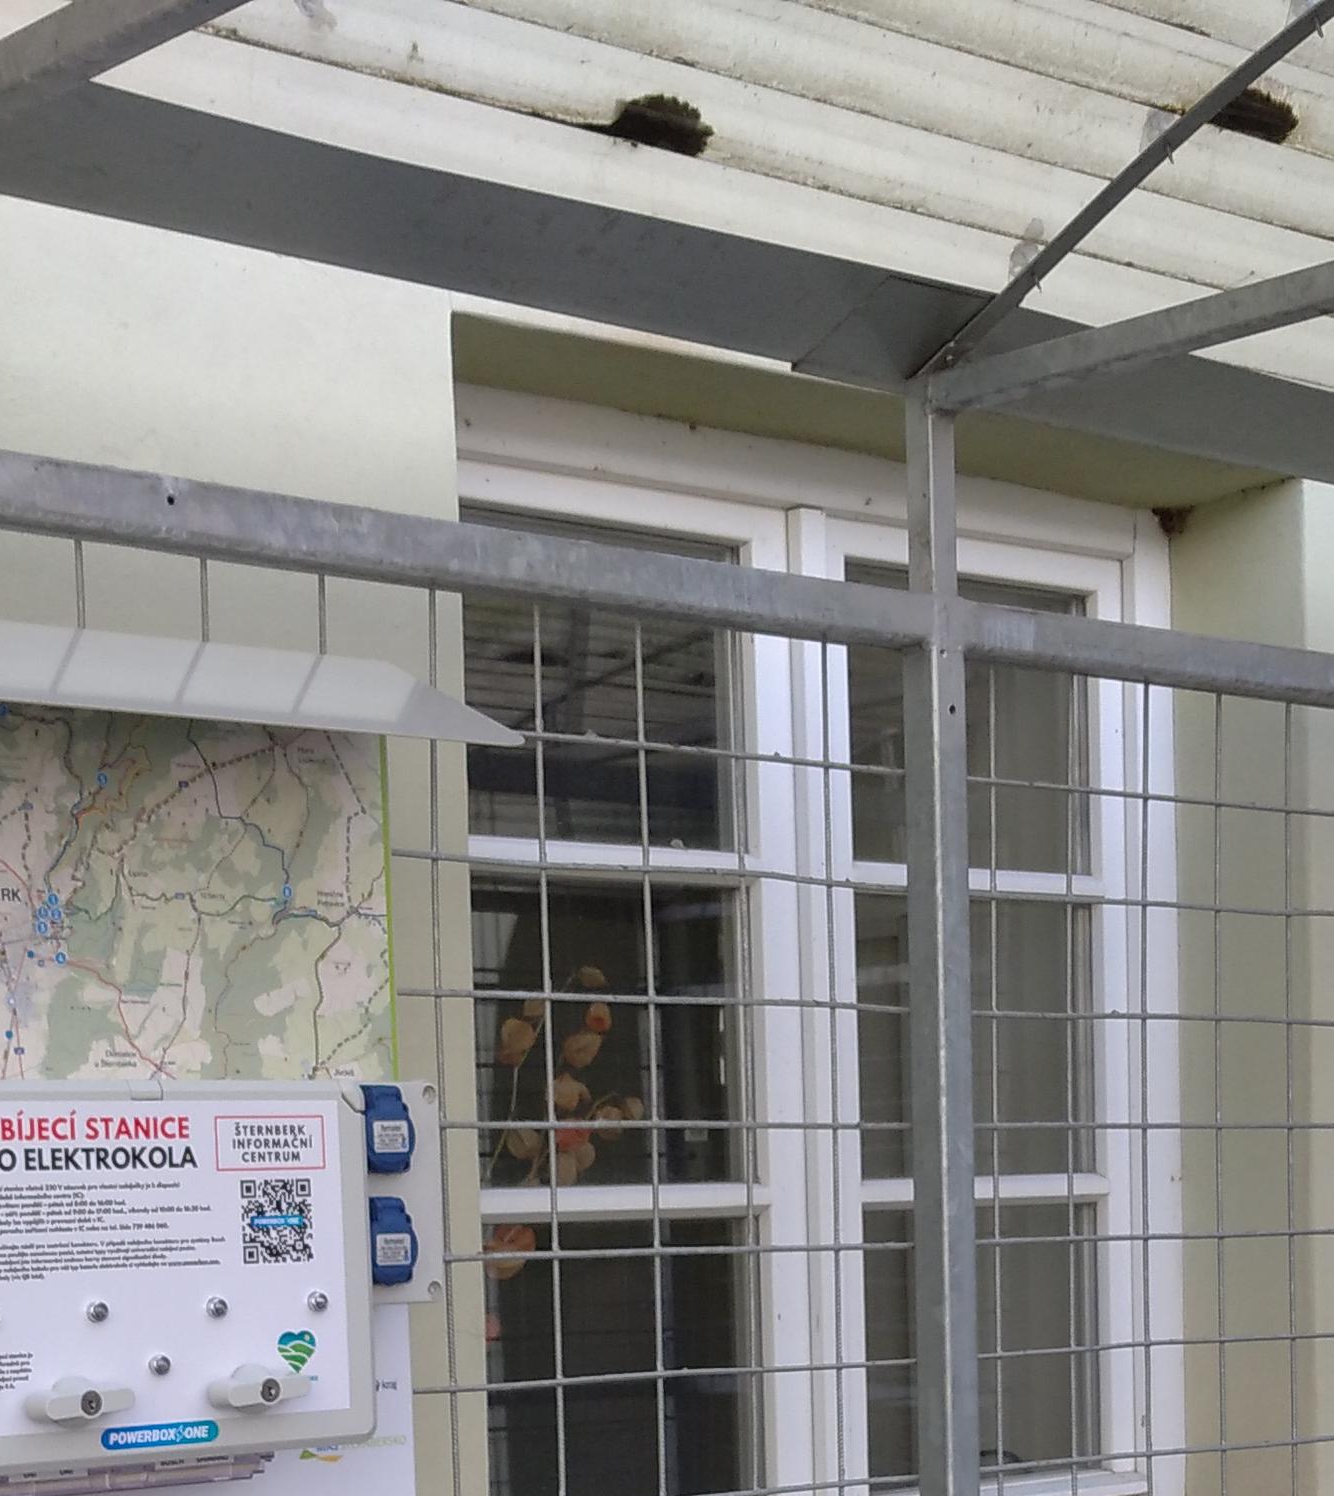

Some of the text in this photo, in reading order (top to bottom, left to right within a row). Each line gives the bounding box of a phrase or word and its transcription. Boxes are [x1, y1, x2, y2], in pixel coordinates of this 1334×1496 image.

[85, 1116, 190, 1141] STANICE
[234, 1121, 306, 1137] ŠTERNBERK
[232, 1134, 313, 1149] INFORMAČNÍ
[23, 1146, 198, 1171] ELEKTROKOLA
[241, 1151, 301, 1163] CENTRUM
[109, 1425, 210, 1446] POWERBOX ONE
